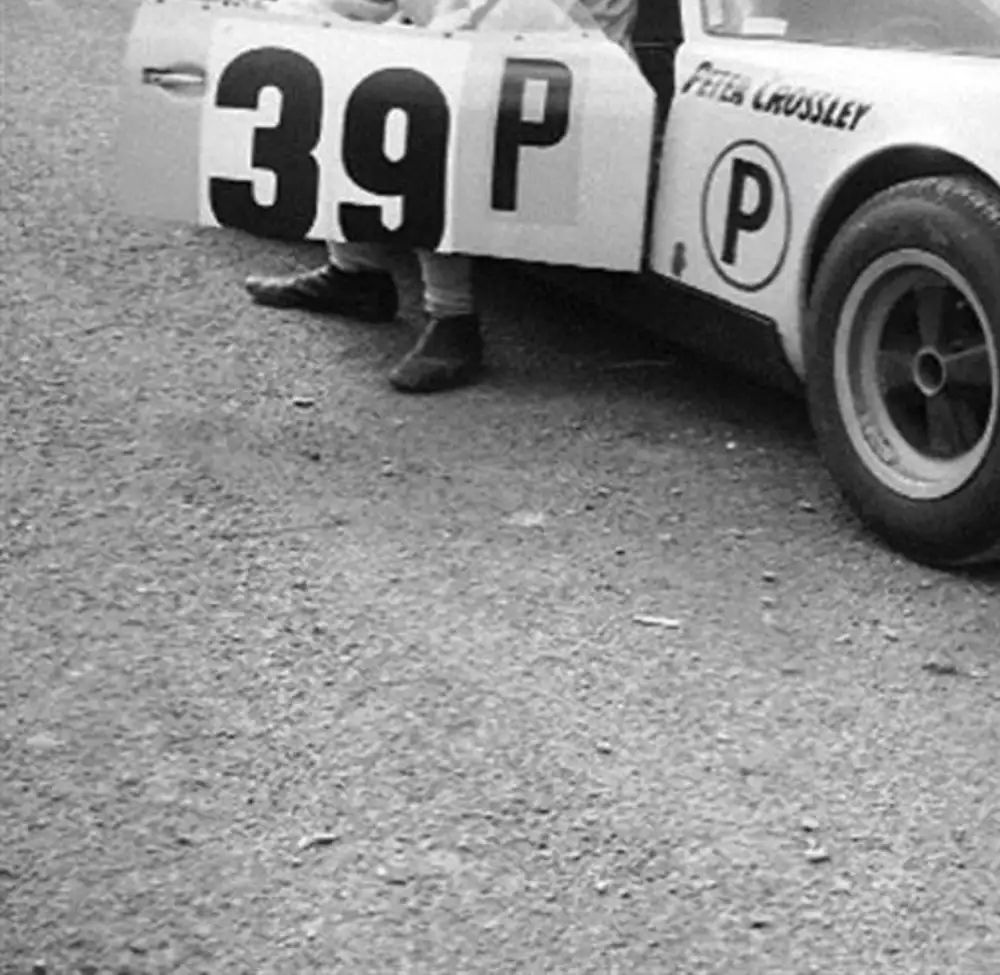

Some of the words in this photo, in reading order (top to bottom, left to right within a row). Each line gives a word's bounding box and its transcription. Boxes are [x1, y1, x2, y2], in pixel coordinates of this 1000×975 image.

[209, 46, 451, 251] 39
[490, 58, 571, 212] P
[752, 80, 872, 131] CROSSLEY
[721, 158, 773, 266] P
